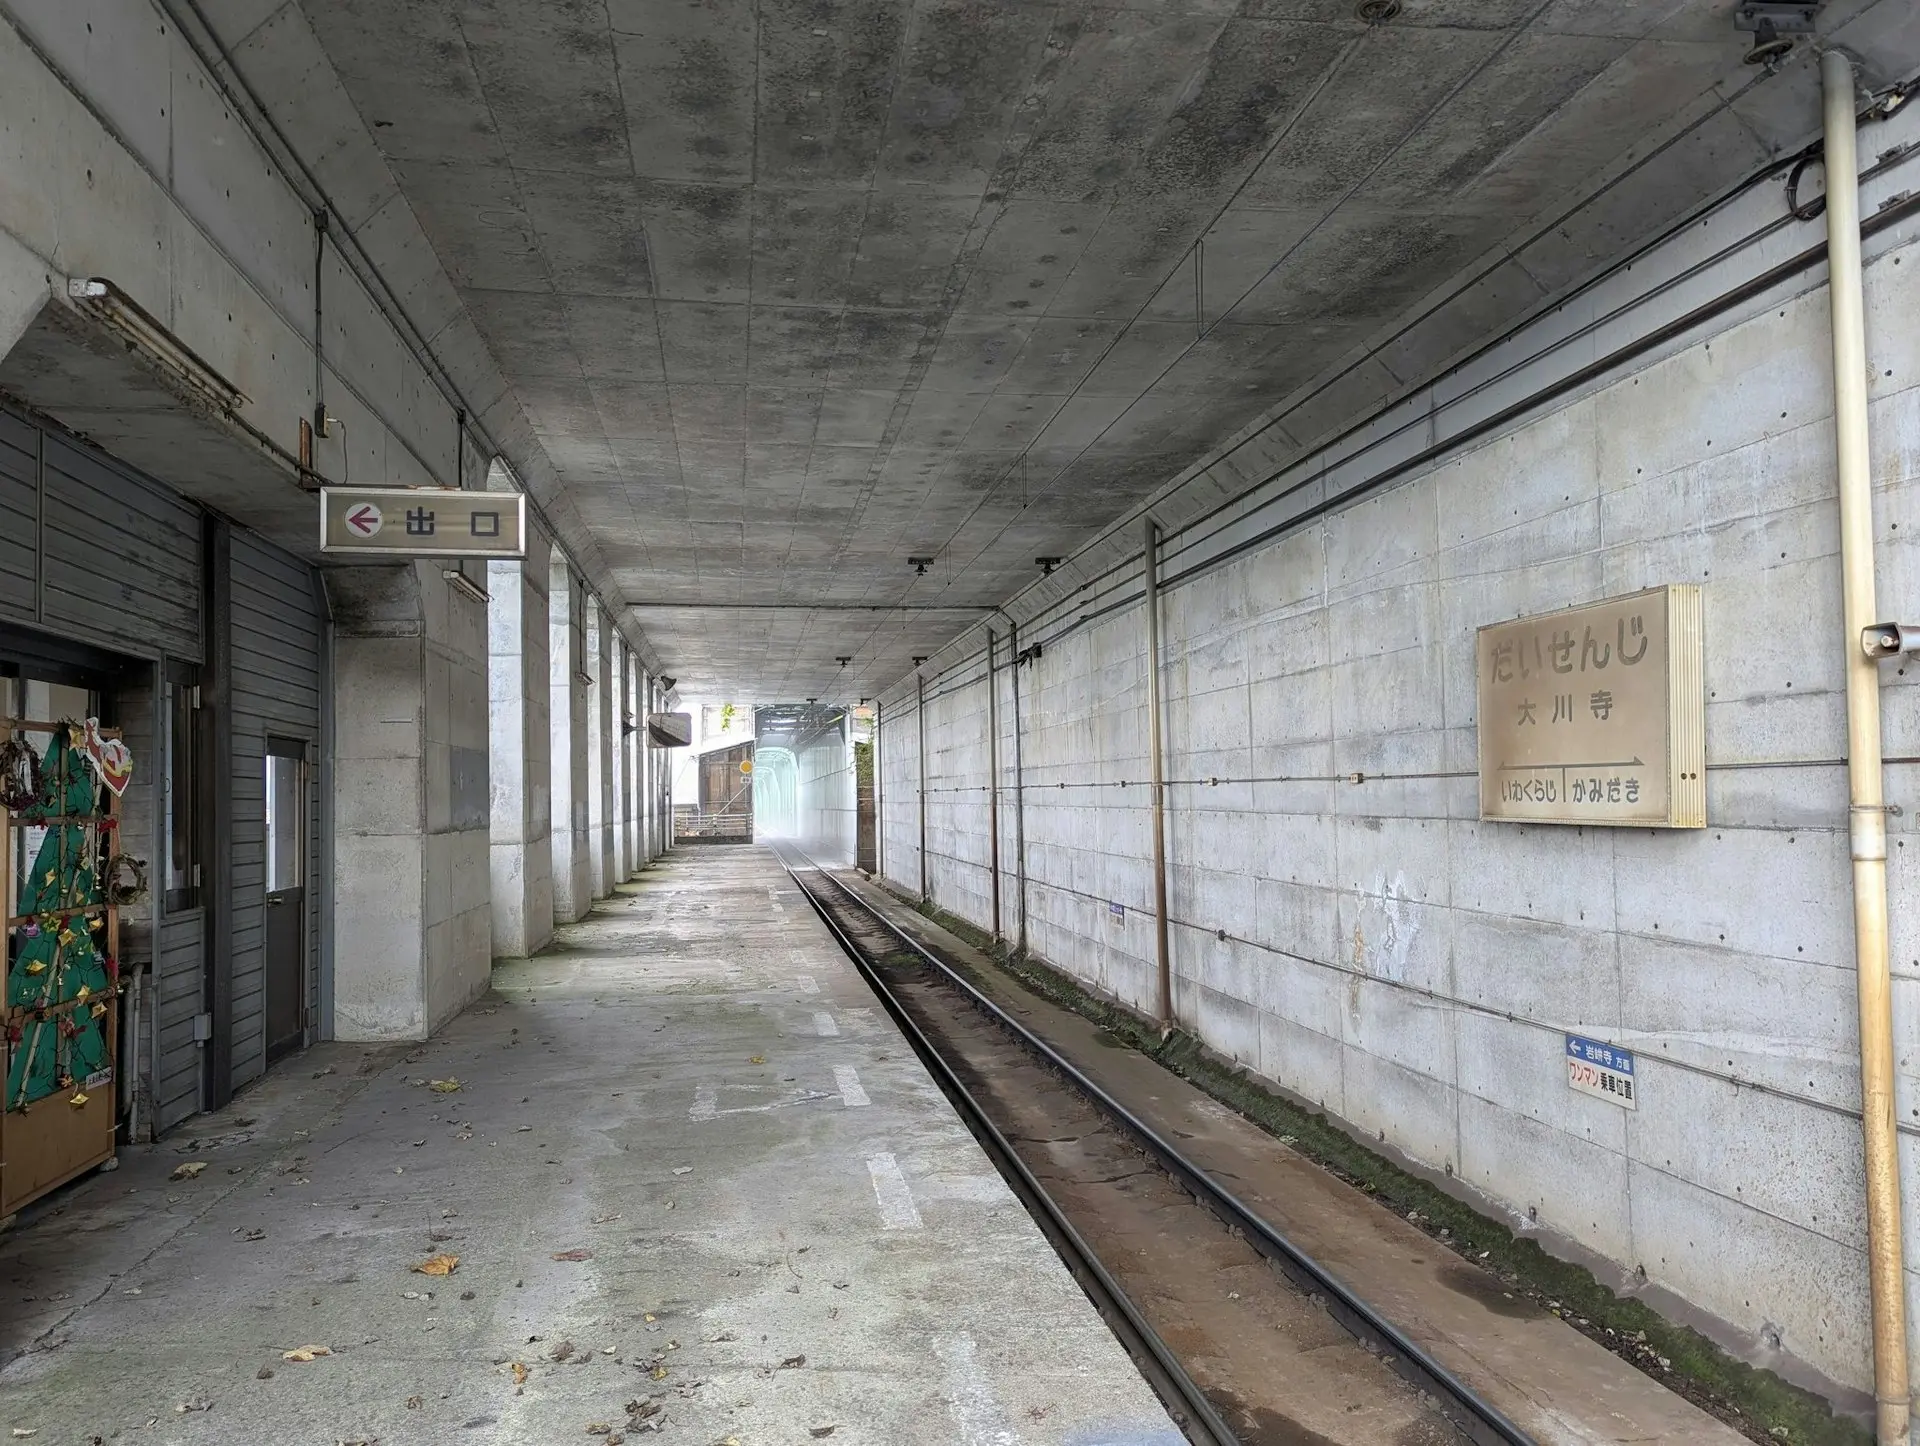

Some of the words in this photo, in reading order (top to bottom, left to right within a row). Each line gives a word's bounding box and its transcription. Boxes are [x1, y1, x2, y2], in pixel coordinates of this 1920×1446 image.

[406, 506, 499, 536] 出口
[1491, 615, 1648, 683] だいせんじ
[1517, 689, 1613, 726] 大川寺
[1501, 779, 1556, 803] いわくらじ
[1572, 777, 1639, 803] かみだき
